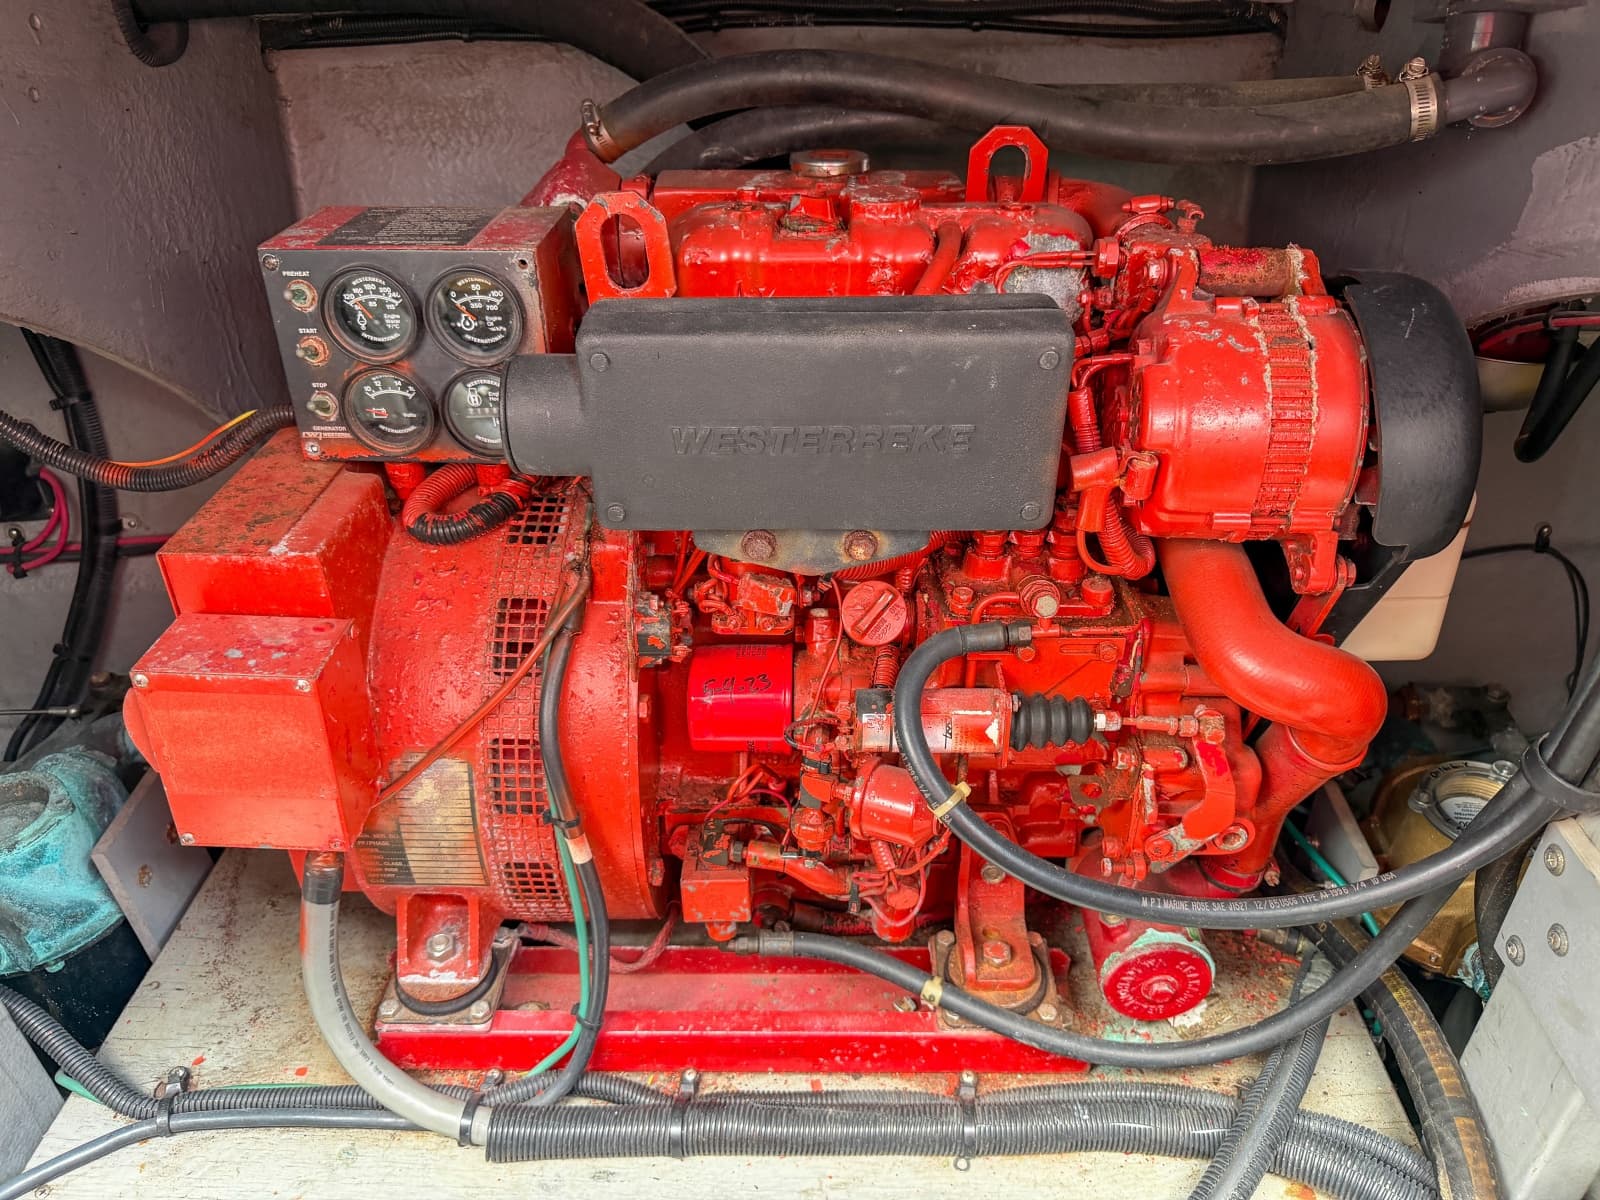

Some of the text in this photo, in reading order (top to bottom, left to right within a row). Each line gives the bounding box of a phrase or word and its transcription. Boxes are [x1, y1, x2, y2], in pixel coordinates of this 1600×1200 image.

[671, 424, 977, 455] WESTERBEKE
[1163, 899, 1189, 911] MARINE
[1191, 901, 1210, 912] HOSE
[1212, 901, 1226, 912] SAE
[1300, 894, 1318, 905] TYPE
[1381, 871, 1398, 883] USA
